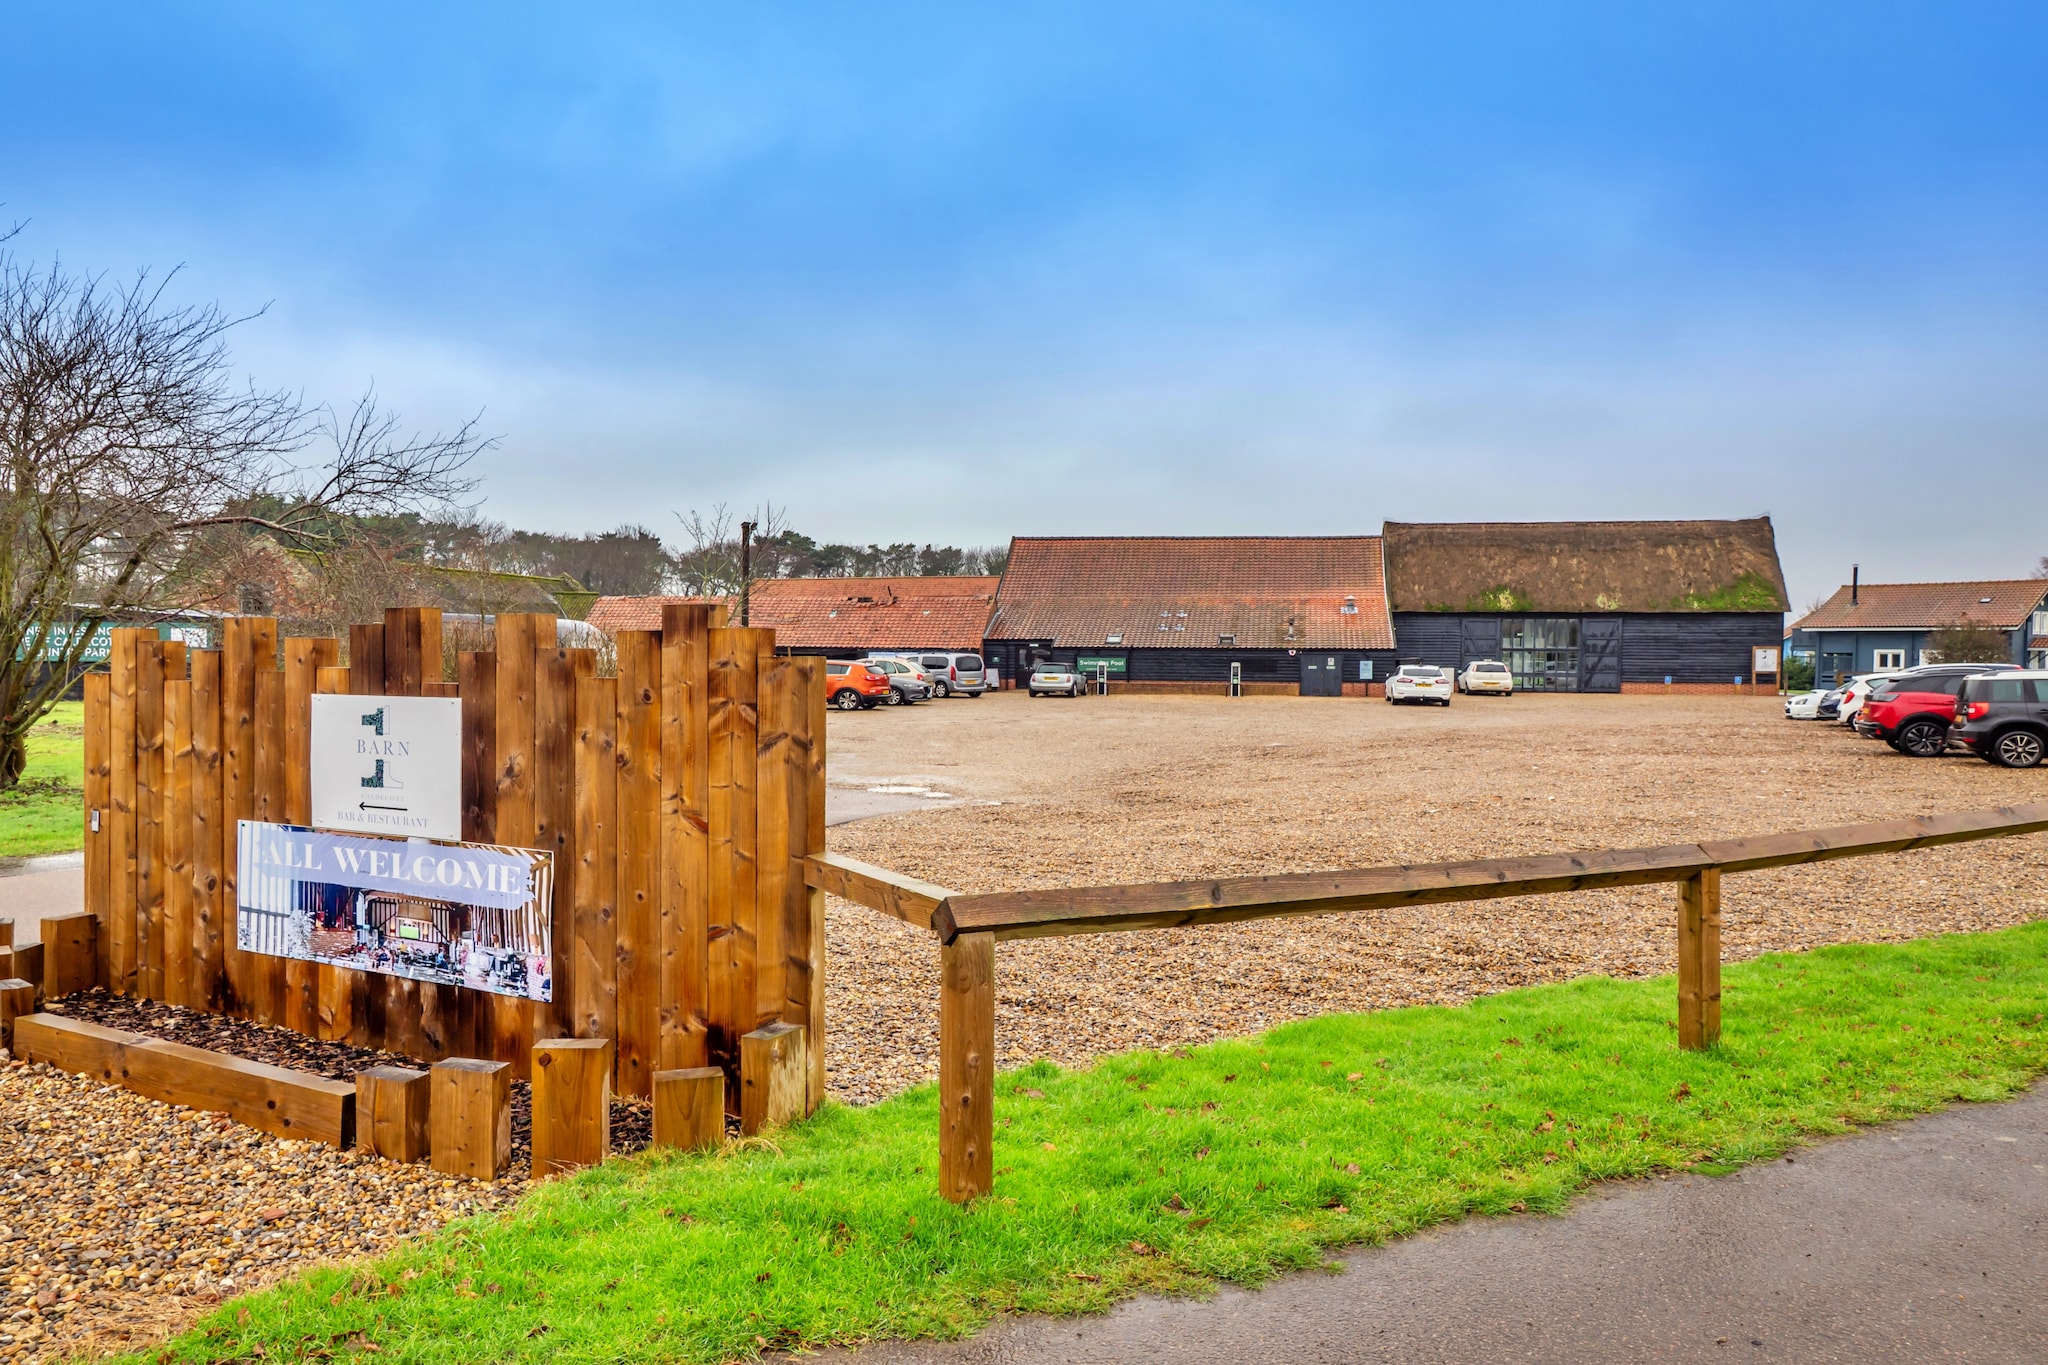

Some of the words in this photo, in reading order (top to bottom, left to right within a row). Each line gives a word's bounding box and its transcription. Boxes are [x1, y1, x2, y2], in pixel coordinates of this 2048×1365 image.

[356, 739, 410, 756] BARN
[337, 810, 355, 821] BAR
[357, 813, 365, 823] &
[367, 813, 429, 828] RESTAURANT
[261, 840, 322, 870] ALL
[333, 846, 521, 895] WELCOME
